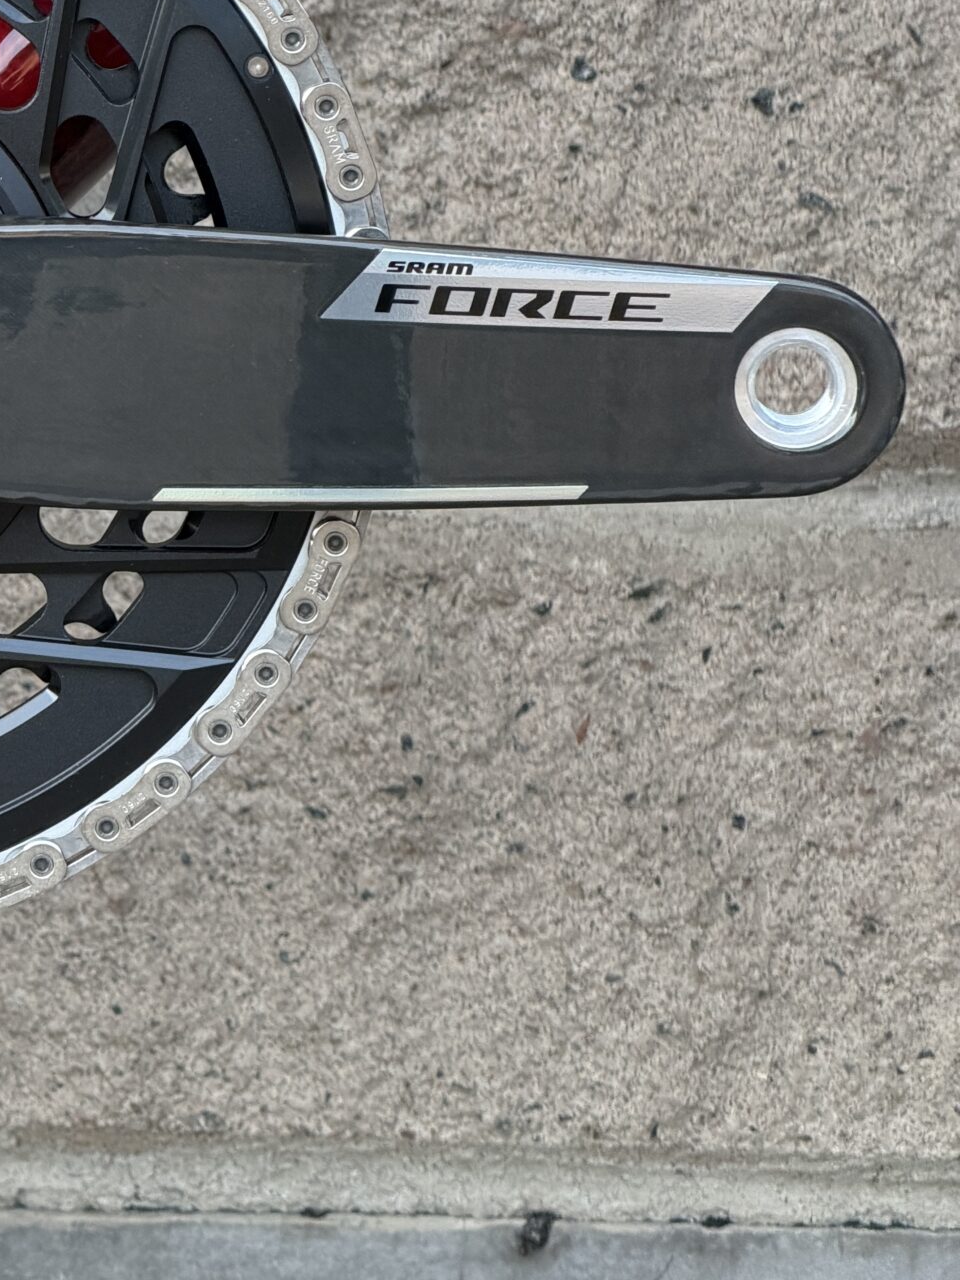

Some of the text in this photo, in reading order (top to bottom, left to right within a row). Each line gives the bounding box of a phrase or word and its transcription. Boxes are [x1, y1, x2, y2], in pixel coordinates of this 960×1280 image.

[322, 124, 346, 165] SRAM
[386, 261, 474, 276] SRAM
[375, 284, 671, 322] FORCE
[302, 556, 329, 597] FORCE
